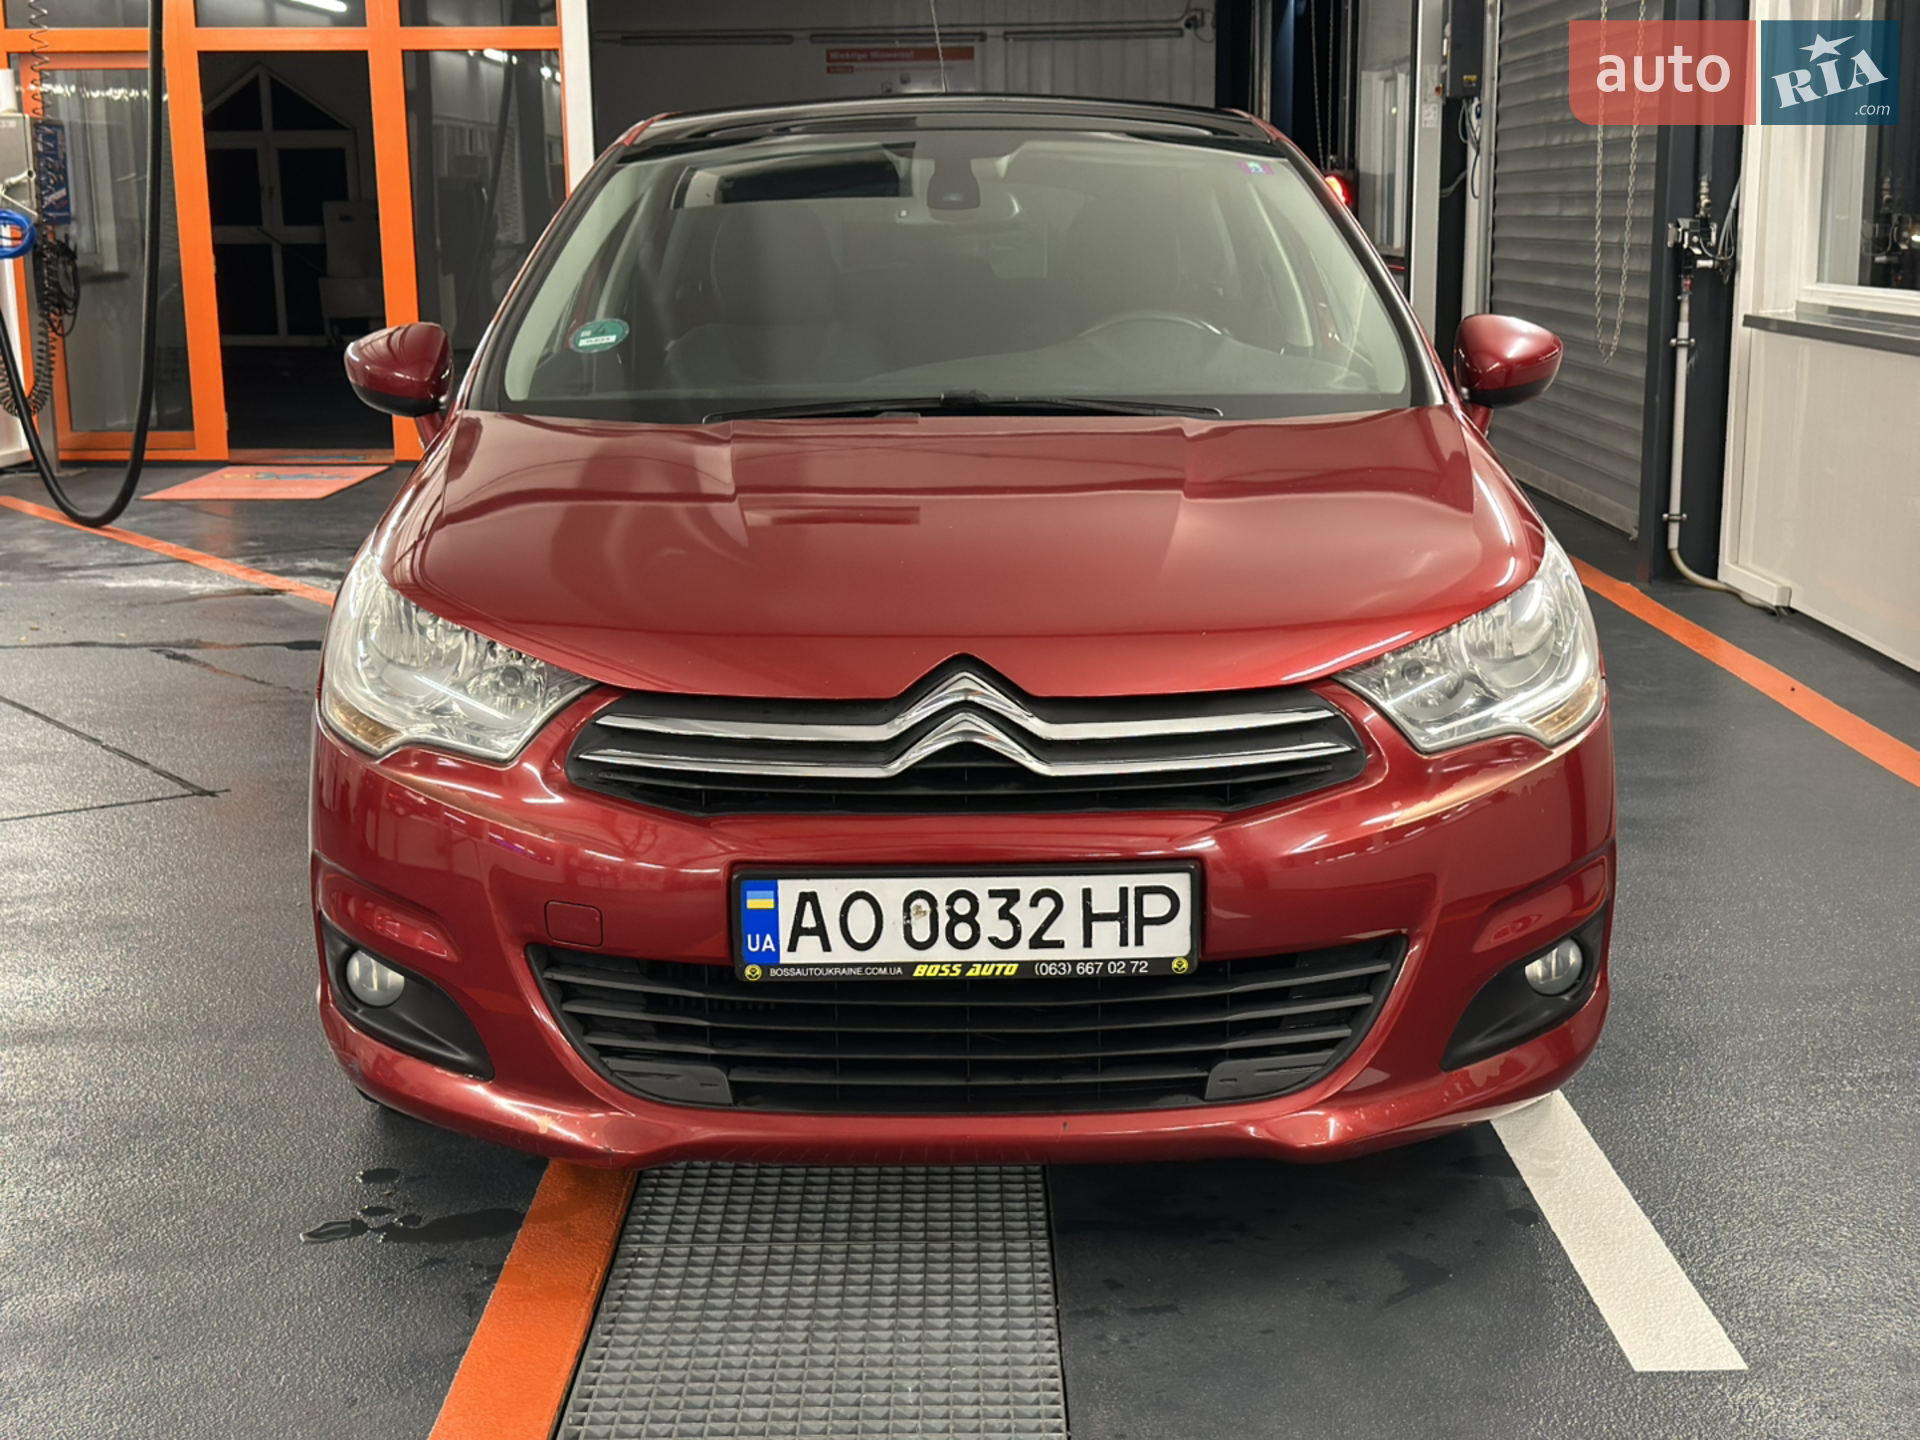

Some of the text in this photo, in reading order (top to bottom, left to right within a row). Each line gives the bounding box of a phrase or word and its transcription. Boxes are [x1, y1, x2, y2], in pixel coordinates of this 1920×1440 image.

[787, 885, 1181, 952] AO 0832 HP
[747, 933, 776, 952] UA
[769, 960, 1149, 977] BOSSAUTOUKRAINE.COM.UA BOSS AUTO (063) 667 02 72
